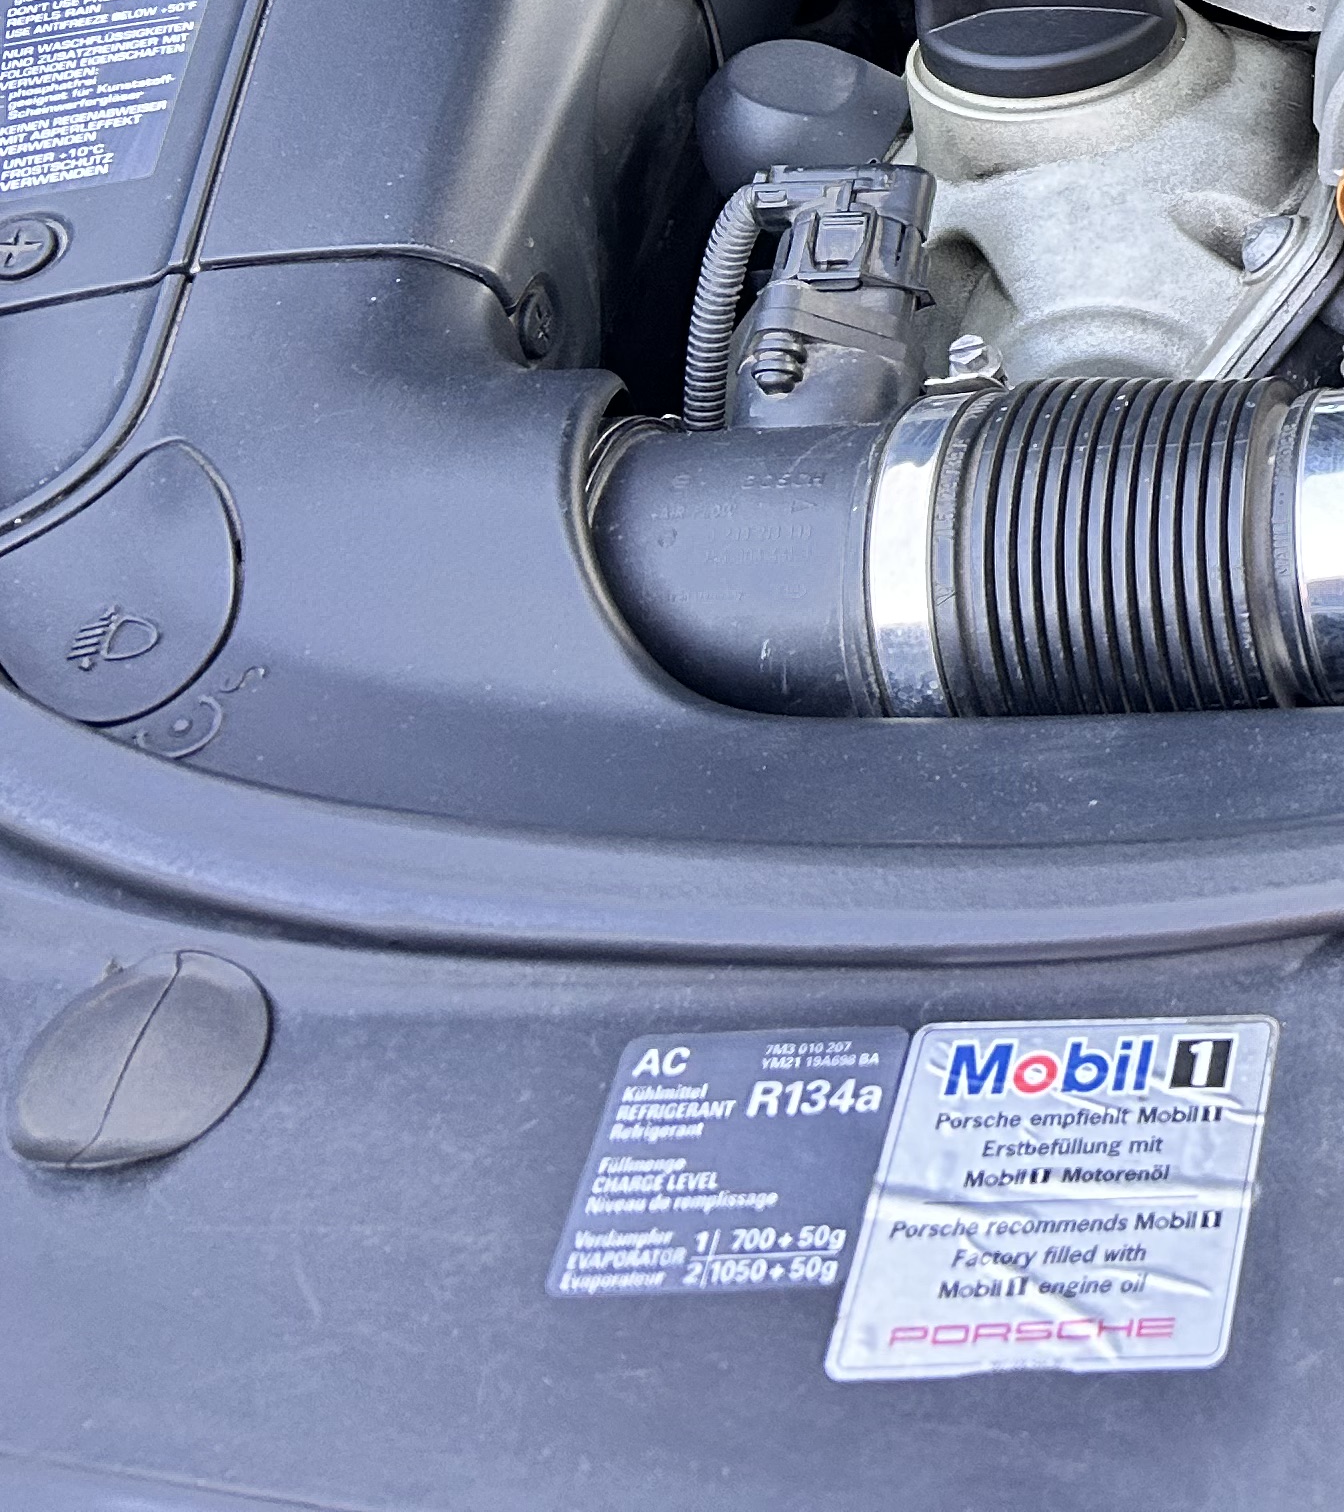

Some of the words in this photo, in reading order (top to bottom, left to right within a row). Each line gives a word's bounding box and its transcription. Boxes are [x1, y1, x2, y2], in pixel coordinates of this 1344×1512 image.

[6, 10, 62, 28] REPELS
[65, 3, 102, 18] RAIN
[6, 26, 32, 40] USE
[1, 56, 35, 71] UND
[162, 32, 190, 45] MIT
[2, 45, 35, 60] NUR
[0, 59, 78, 81] FOLGENDEN
[0, 66, 100, 91] VERWENDEN:
[0, 132, 28, 146] MIT
[0, 131, 97, 157] VERWENDEN
[1, 152, 115, 182] FROSTSCHUTZ
[3, 151, 55, 170] UNTER
[0, 163, 109, 192] VERWENDEN
[631, 1045, 691, 1078] AC
[943, 1037, 1151, 1096] Mobil
[616, 1099, 737, 1122] REFRIGERANT
[746, 1078, 883, 1118] R134a
[934, 1110, 1022, 1130] Porsche
[1029, 1107, 1129, 1129] empfiehlt
[981, 1138, 1121, 1158] Erstbefüllung
[1128, 1136, 1163, 1153] mit
[592, 1173, 665, 1195] CHARGE
[666, 1171, 718, 1192] LEVEL
[1061, 1164, 1170, 1183] Motorenöl
[732, 1226, 777, 1251] 700
[798, 1224, 847, 1251] 50g
[889, 1218, 979, 1239] Porsche
[984, 1213, 1127, 1236] recommends
[566, 1247, 688, 1270] EVAPORATOR
[951, 1249, 1037, 1270] Factory
[1042, 1245, 1096, 1265] filled
[1103, 1243, 1147, 1263] with
[682, 1261, 702, 1285] 2
[710, 1259, 768, 1285] 1050
[789, 1256, 840, 1285] 50g
[1038, 1278, 1112, 1299] engine
[1120, 1273, 1148, 1293] oil
[888, 1317, 1177, 1349] PORSCHE
